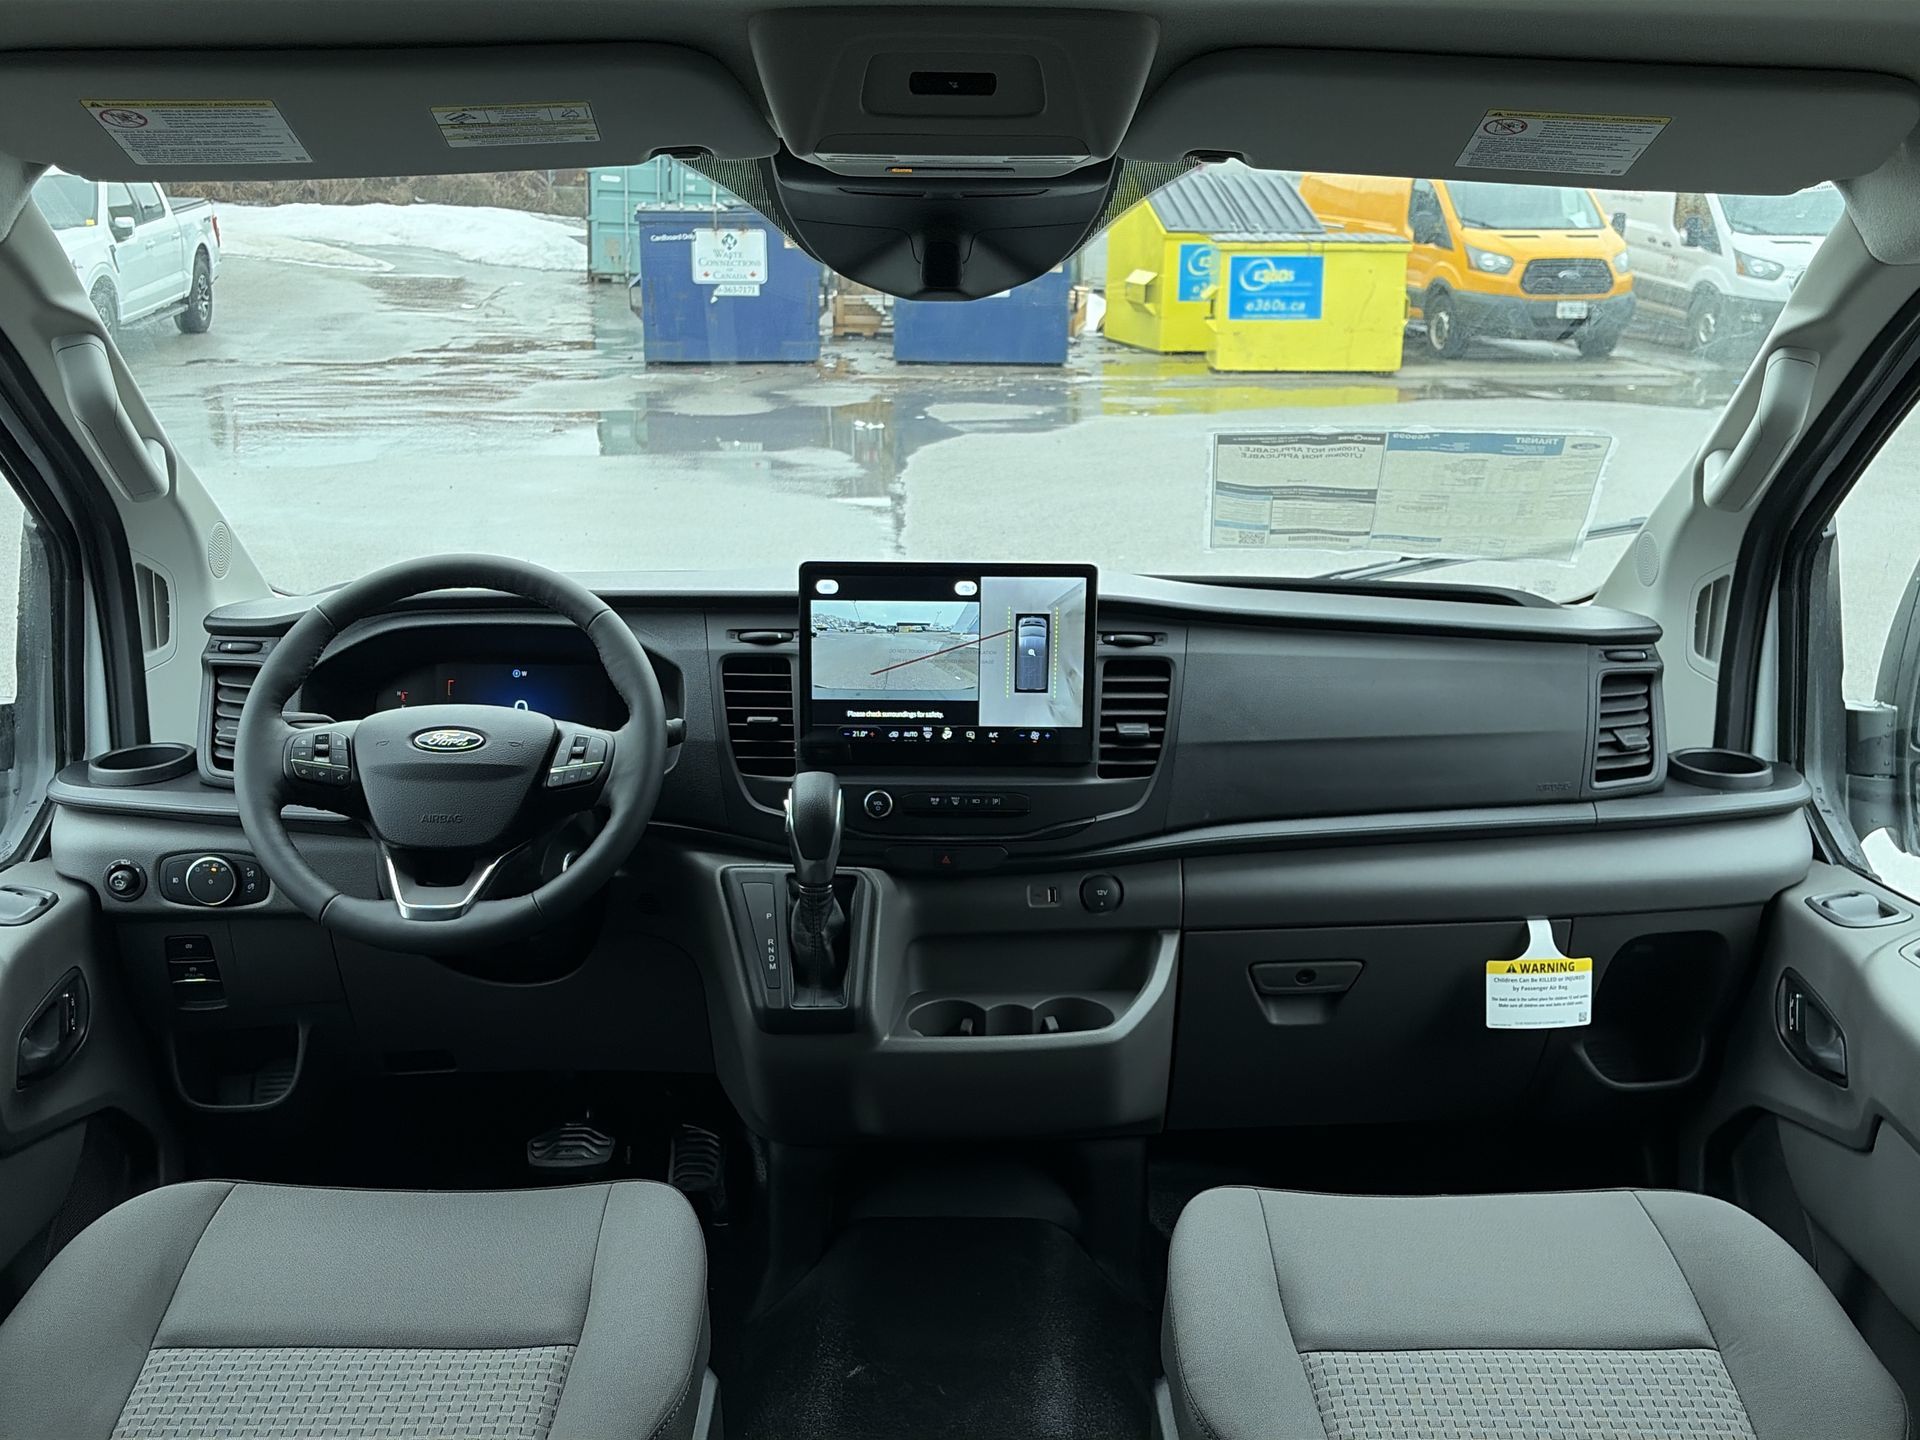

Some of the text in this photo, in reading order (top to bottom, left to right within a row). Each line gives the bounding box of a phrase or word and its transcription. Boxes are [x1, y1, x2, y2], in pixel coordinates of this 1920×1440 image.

[650, 233, 681, 242] Cardboard
[847, 710, 944, 719] Please check surroundings for safety.
[427, 731, 471, 746] Ford
[421, 813, 463, 824] AIRBAG
[766, 912, 772, 920] P
[767, 938, 774, 946] R
[768, 946, 775, 954] N
[769, 962, 777, 970] M
[1520, 961, 1575, 974] WARNING
